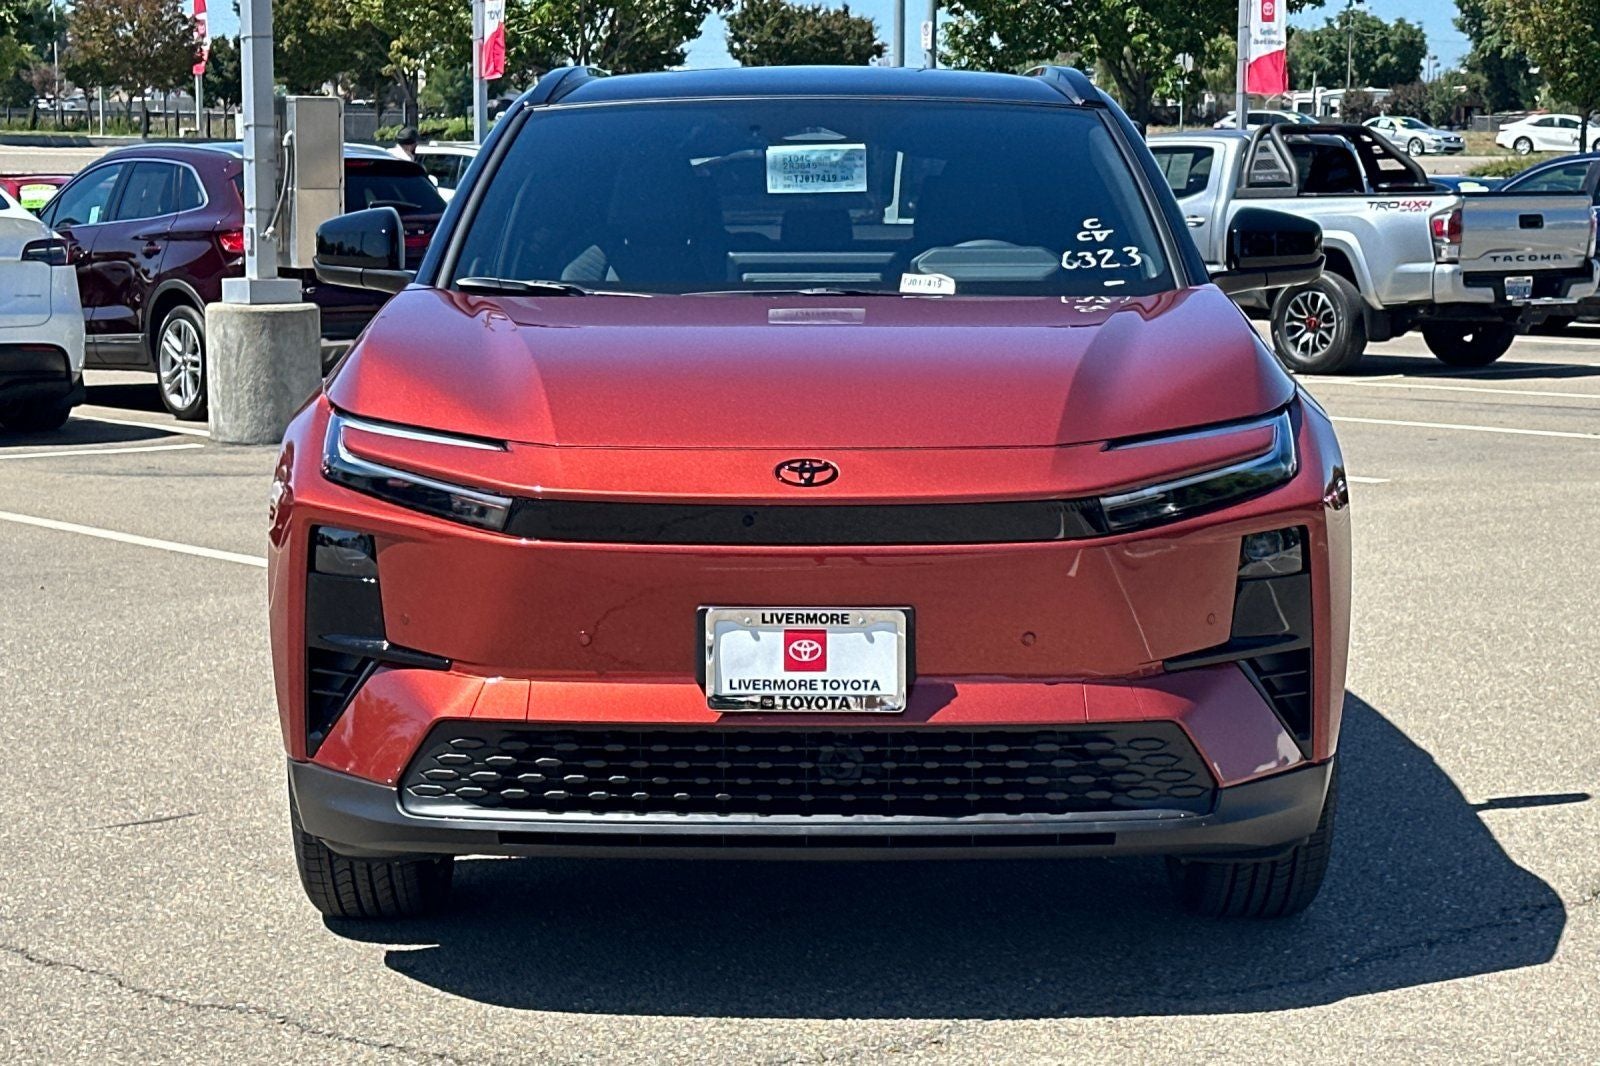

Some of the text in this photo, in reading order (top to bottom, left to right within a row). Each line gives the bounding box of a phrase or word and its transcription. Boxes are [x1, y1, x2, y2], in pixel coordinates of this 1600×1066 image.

[794, 174, 837, 183] TJ017419
[1061, 246, 1142, 270] 6323
[1489, 254, 1562, 263] TACOMA
[761, 612, 850, 625] LIVERMORE
[729, 679, 881, 691] LIVERMORE TOYOTA
[779, 696, 850, 710] TOYOTA
